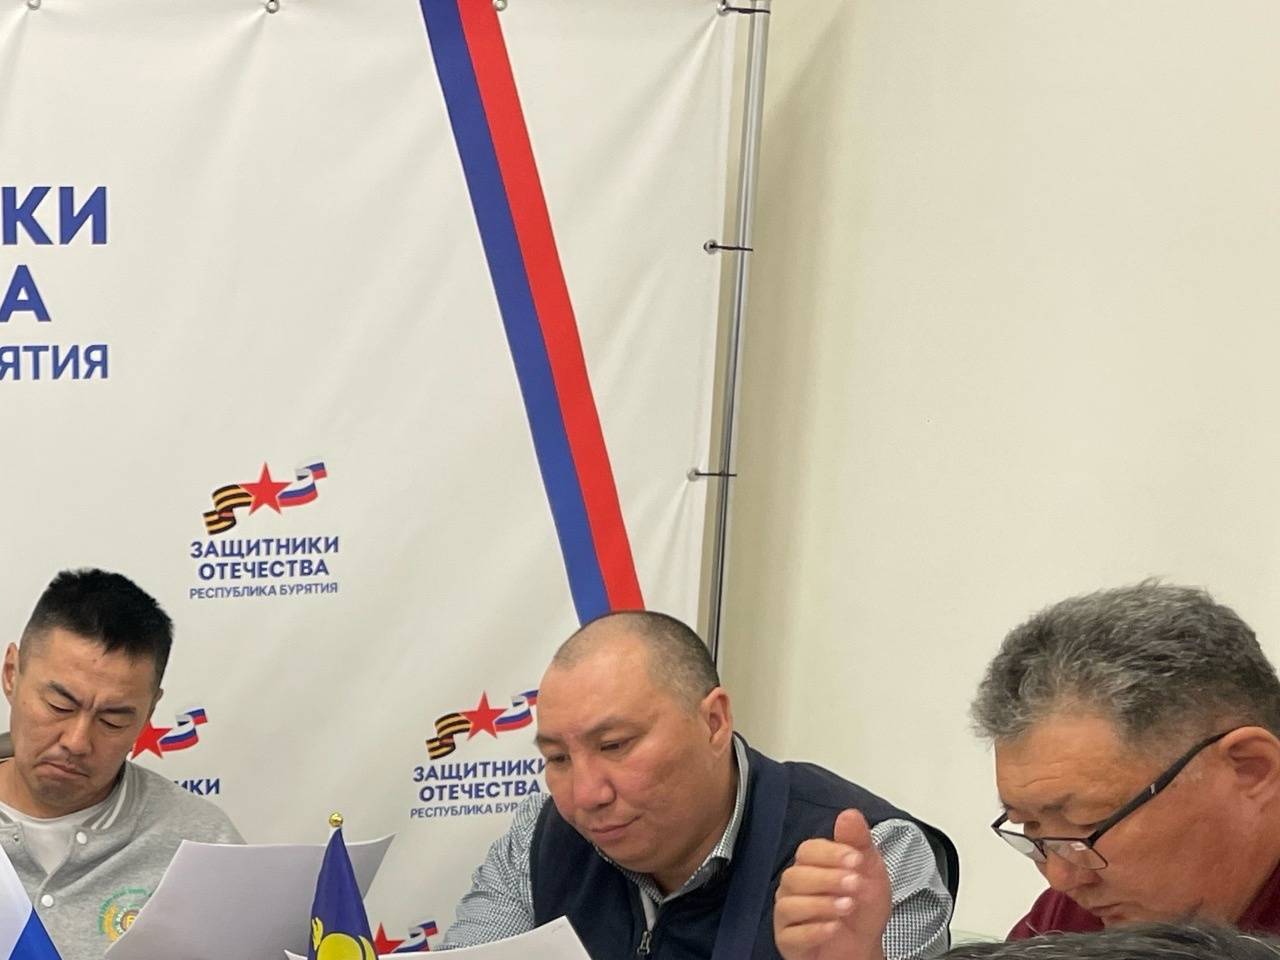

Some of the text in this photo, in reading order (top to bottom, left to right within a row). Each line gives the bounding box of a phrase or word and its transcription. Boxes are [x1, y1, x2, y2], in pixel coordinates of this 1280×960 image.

[190, 536, 339, 562] ЗАЩИТНИКИ
[198, 558, 330, 581] ОТЕЧЕСТВА
[189, 582, 338, 600] РЕСПУБЛИКА БУРЯТИЯ
[419, 779, 541, 802] ОТЕЧЕСТВА
[410, 804, 493, 819] РЕСПУБЛИКА
